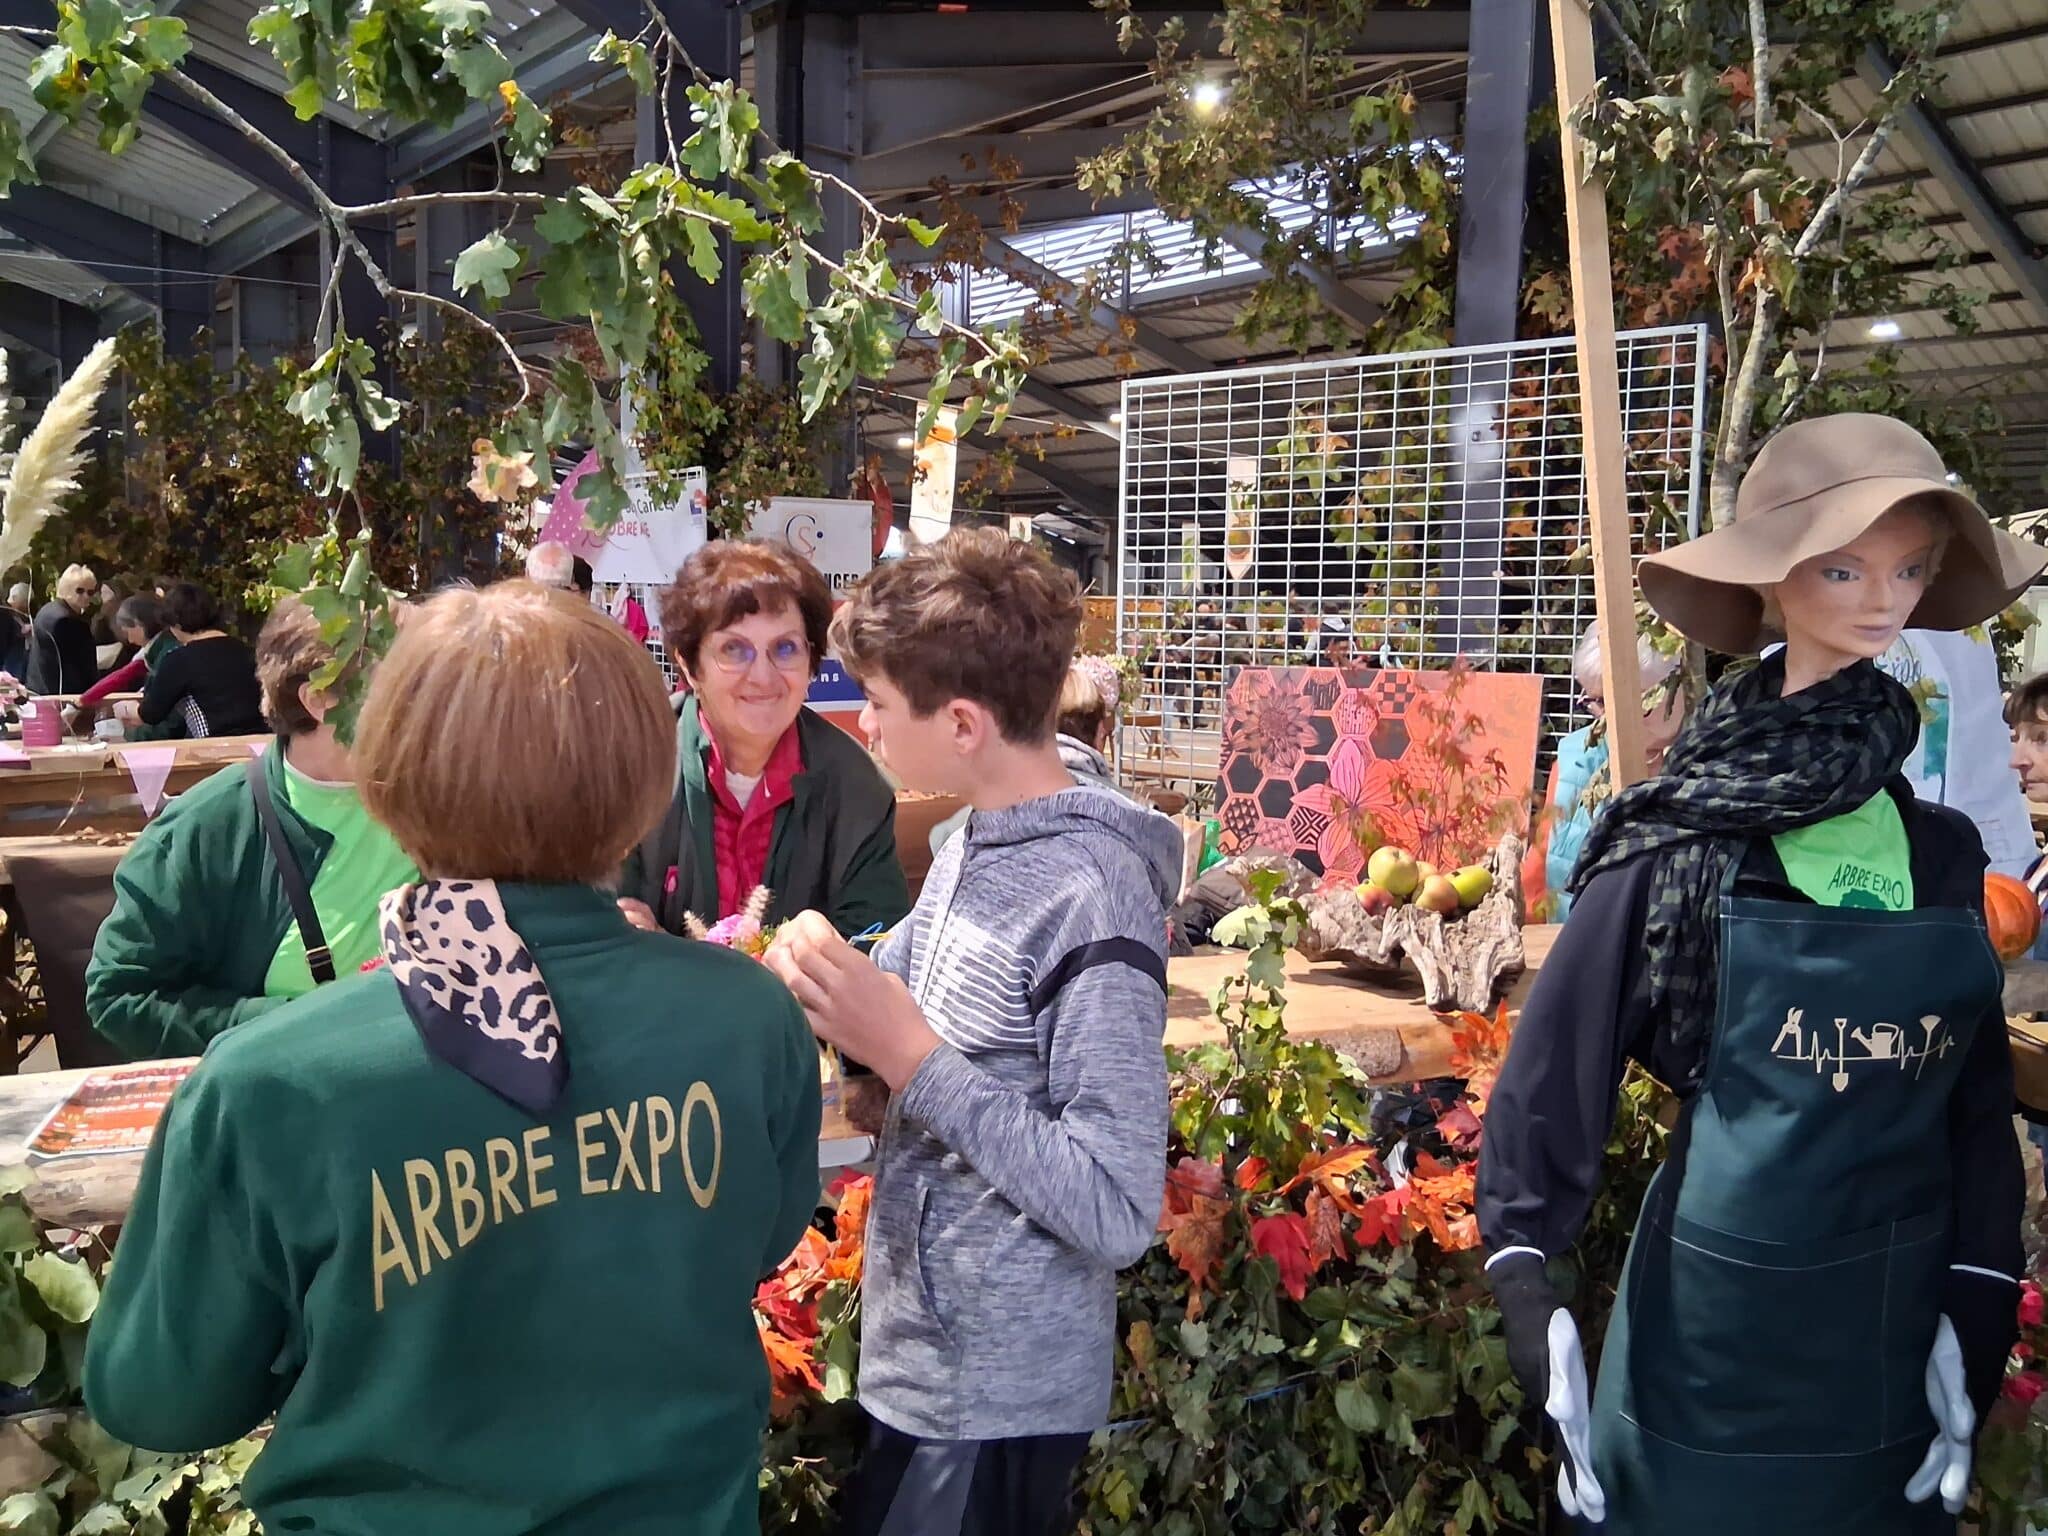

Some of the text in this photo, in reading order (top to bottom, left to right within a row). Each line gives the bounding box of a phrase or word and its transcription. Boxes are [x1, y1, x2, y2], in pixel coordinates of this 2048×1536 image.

[1827, 862, 1905, 909] ARBRE EXPO
[371, 1080, 722, 1312] ARBRE EXPO
